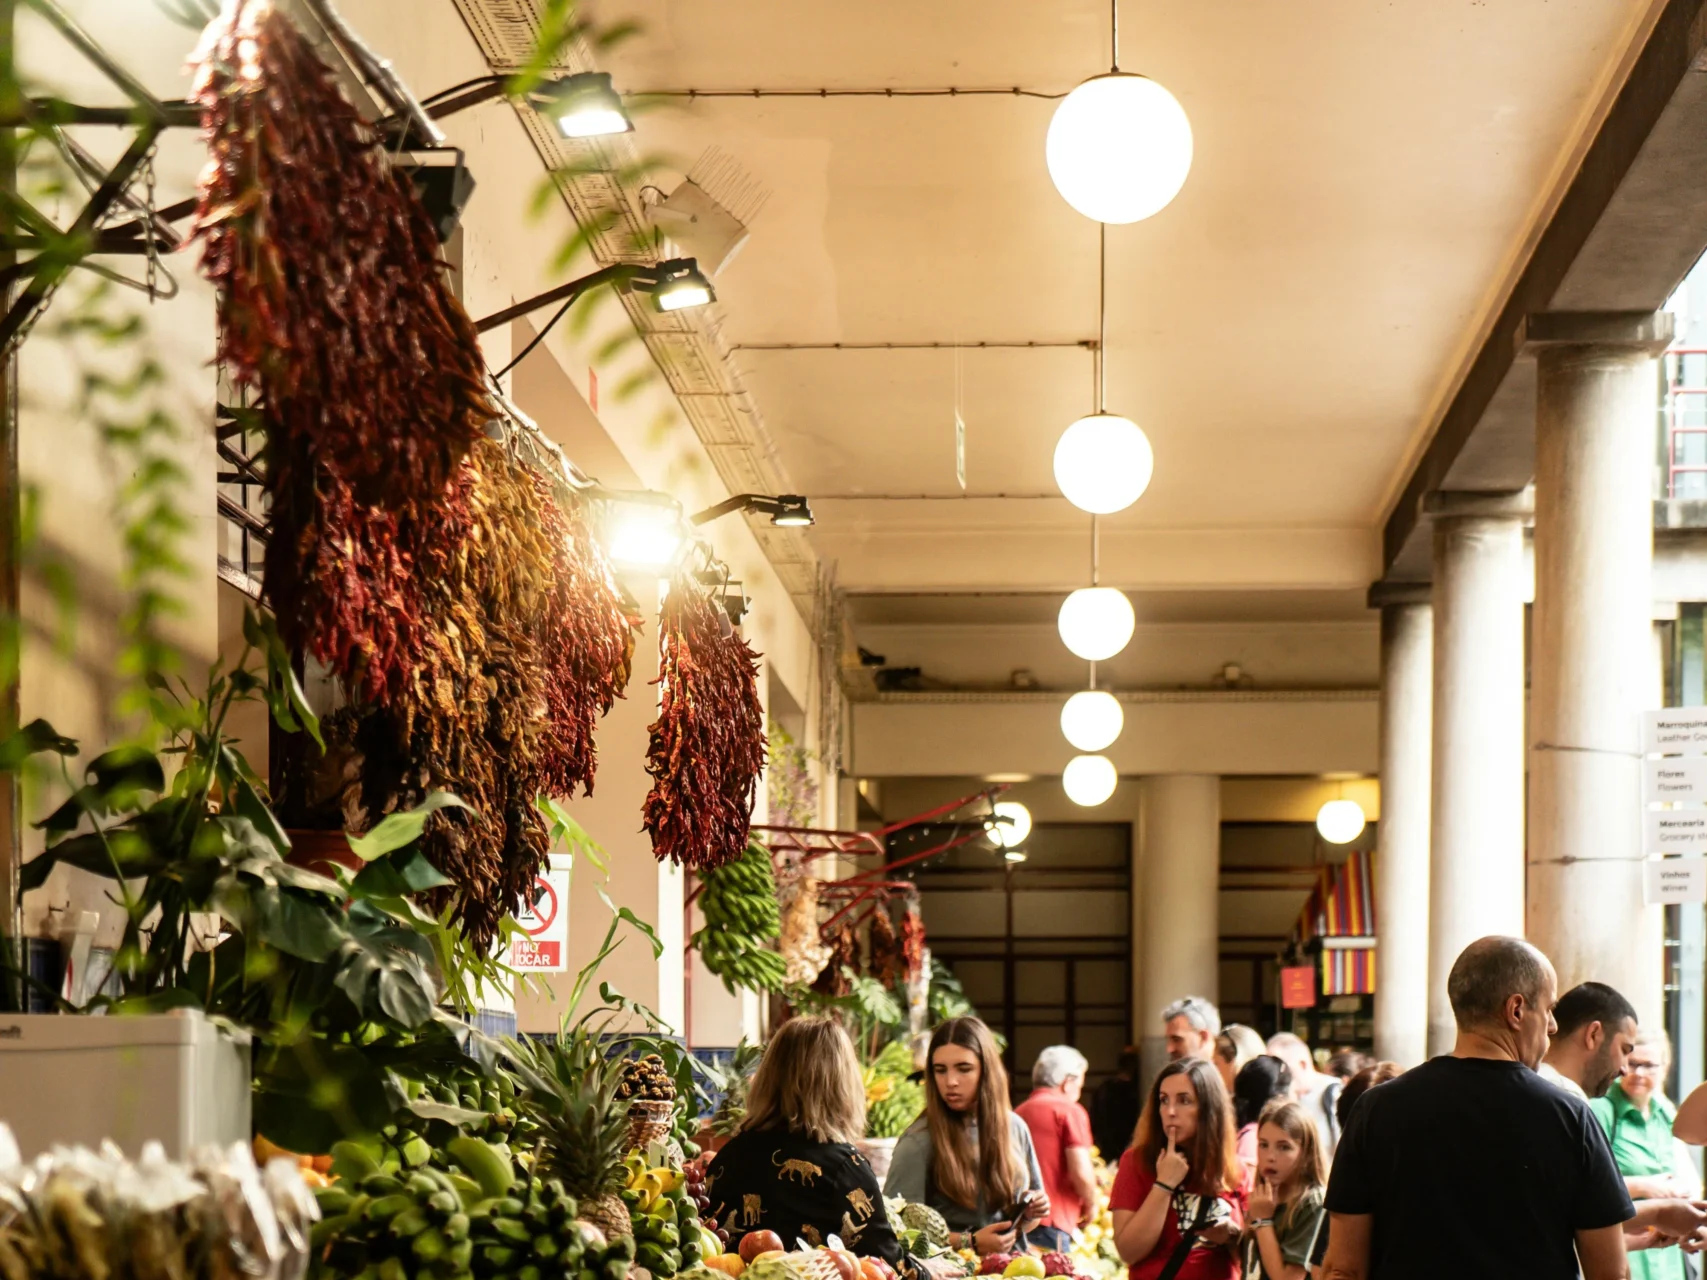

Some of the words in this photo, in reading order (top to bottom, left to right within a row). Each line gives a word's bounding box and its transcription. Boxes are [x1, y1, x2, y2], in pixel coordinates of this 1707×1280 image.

[1657, 734, 1690, 743] Leather
[1657, 770, 1685, 778] Flores
[1657, 783, 1693, 791] Flowers
[1659, 819, 1705, 828] Mercearia
[1659, 833, 1694, 843] Grocery
[1697, 832, 1707, 841] st
[1660, 871, 1691, 879] Vinhos
[1660, 884, 1688, 892] Wines
